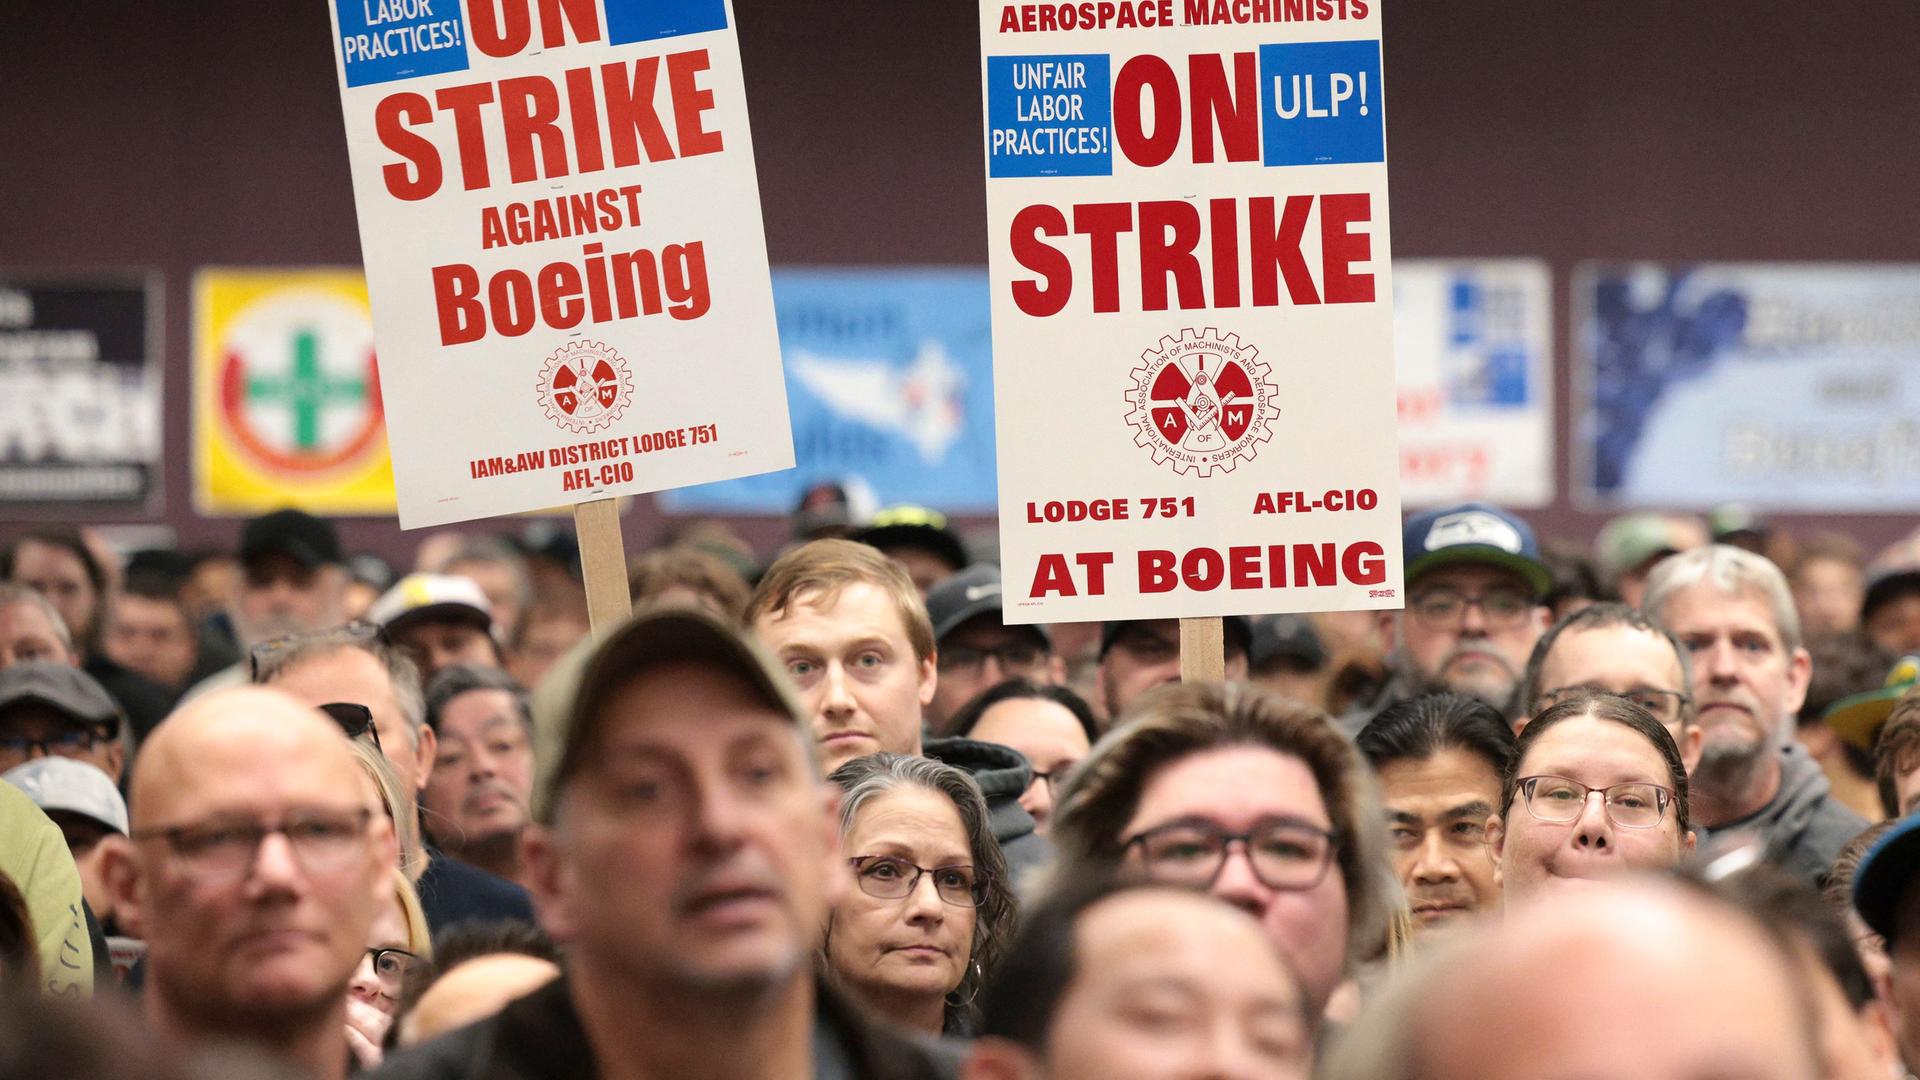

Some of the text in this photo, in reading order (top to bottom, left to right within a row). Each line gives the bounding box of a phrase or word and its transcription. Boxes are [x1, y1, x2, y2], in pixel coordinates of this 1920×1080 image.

[364, 0, 433, 26] LABOR
[1000, 0, 1369, 33] AEROSPACE MACHINISTS
[343, 19, 461, 64] PRACTICES!
[1013, 62, 1087, 90] UNFAIR
[1017, 94, 1085, 122] LABOR
[1113, 52, 1260, 168] ON
[1274, 71, 1369, 120] ULP!
[375, 48, 724, 201] STRIKE
[992, 126, 1108, 156] PRACTICES!
[481, 184, 642, 250] AGAINST
[1010, 192, 1376, 318] STRIKE
[431, 240, 712, 347] Boeing
[562, 389, 612, 406] A M
[1139, 341, 1266, 463] INTERNATIONAL ASSOCIATION OF MACHINISTS AND AEROSPACE WORKERS
[1163, 411, 1244, 428] A M
[470, 423, 718, 479] IAM&AW DISTRICT LODGE 751
[1197, 434, 1212, 443] OF
[563, 461, 634, 491] AFL-CIO
[1027, 496, 1196, 524] LODGE 751
[1253, 488, 1378, 515] AFL-CIO
[1029, 540, 1386, 598] AT BOEING
